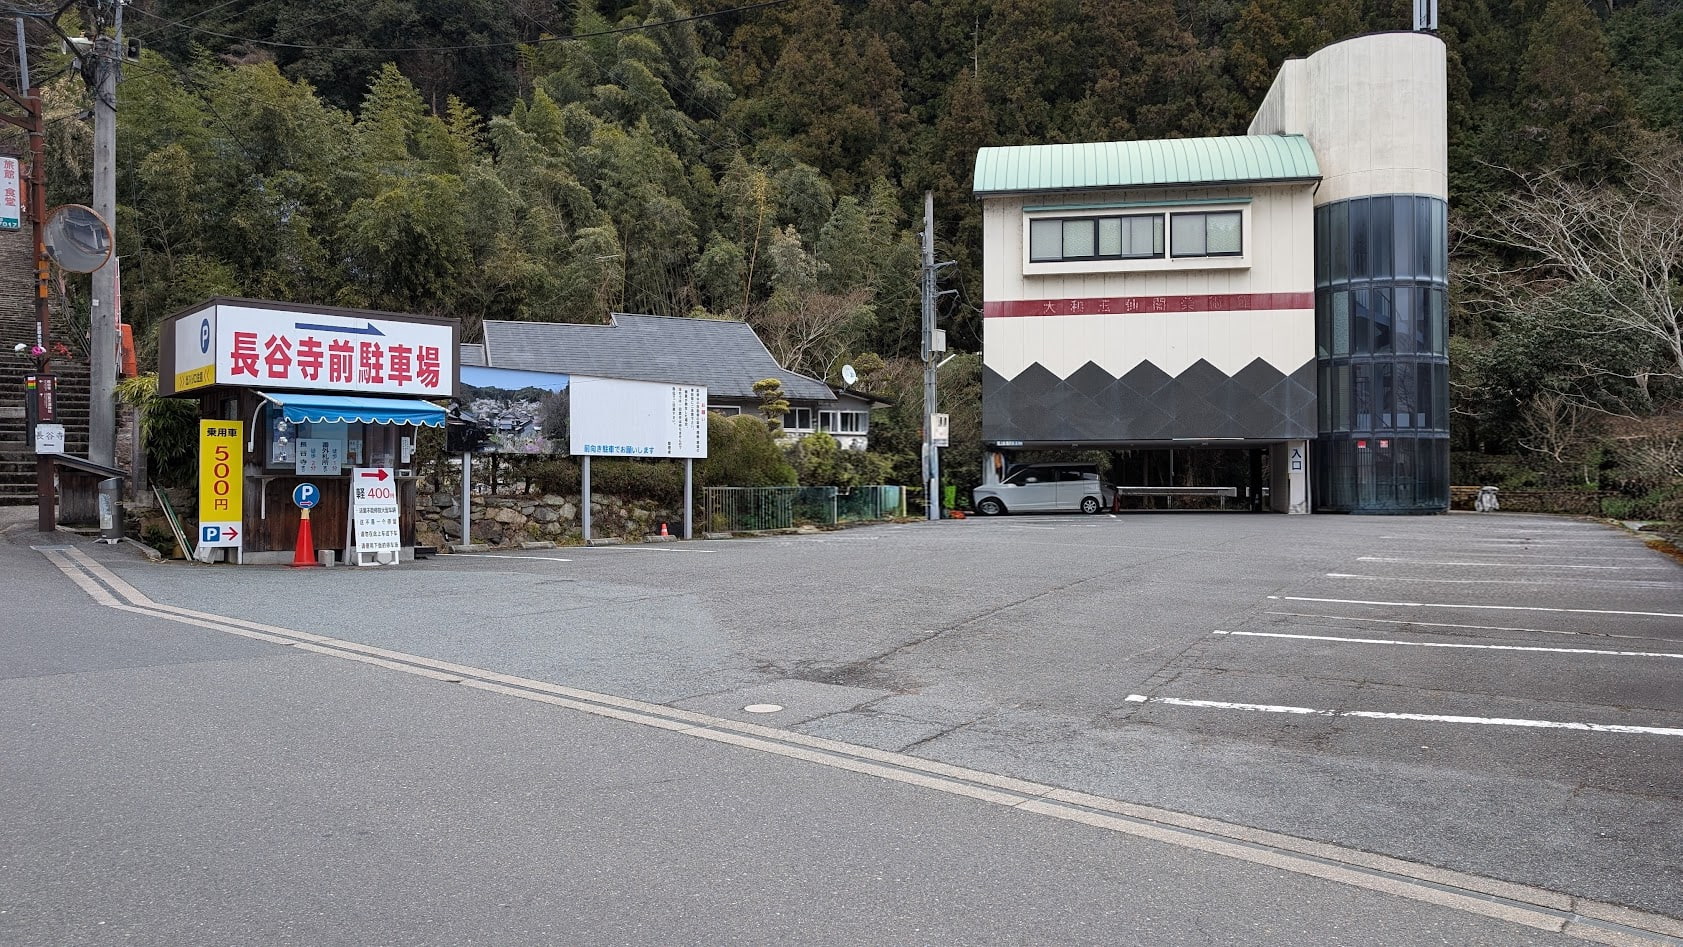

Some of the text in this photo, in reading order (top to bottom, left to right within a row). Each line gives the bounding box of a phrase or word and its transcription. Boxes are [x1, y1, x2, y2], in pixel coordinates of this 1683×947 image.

[3, 160, 16, 207] 旅館・食堂
[230, 331, 440, 388] 長谷寺前駐車場
[36, 431, 64, 441] 長谷寺
[206, 427, 238, 438] 乗用車
[584, 444, 655, 455] 前向き駐車でお願いします
[1291, 448, 1302, 471] 入口
[301, 485, 314, 501] P
[356, 488, 366, 500] 軽
